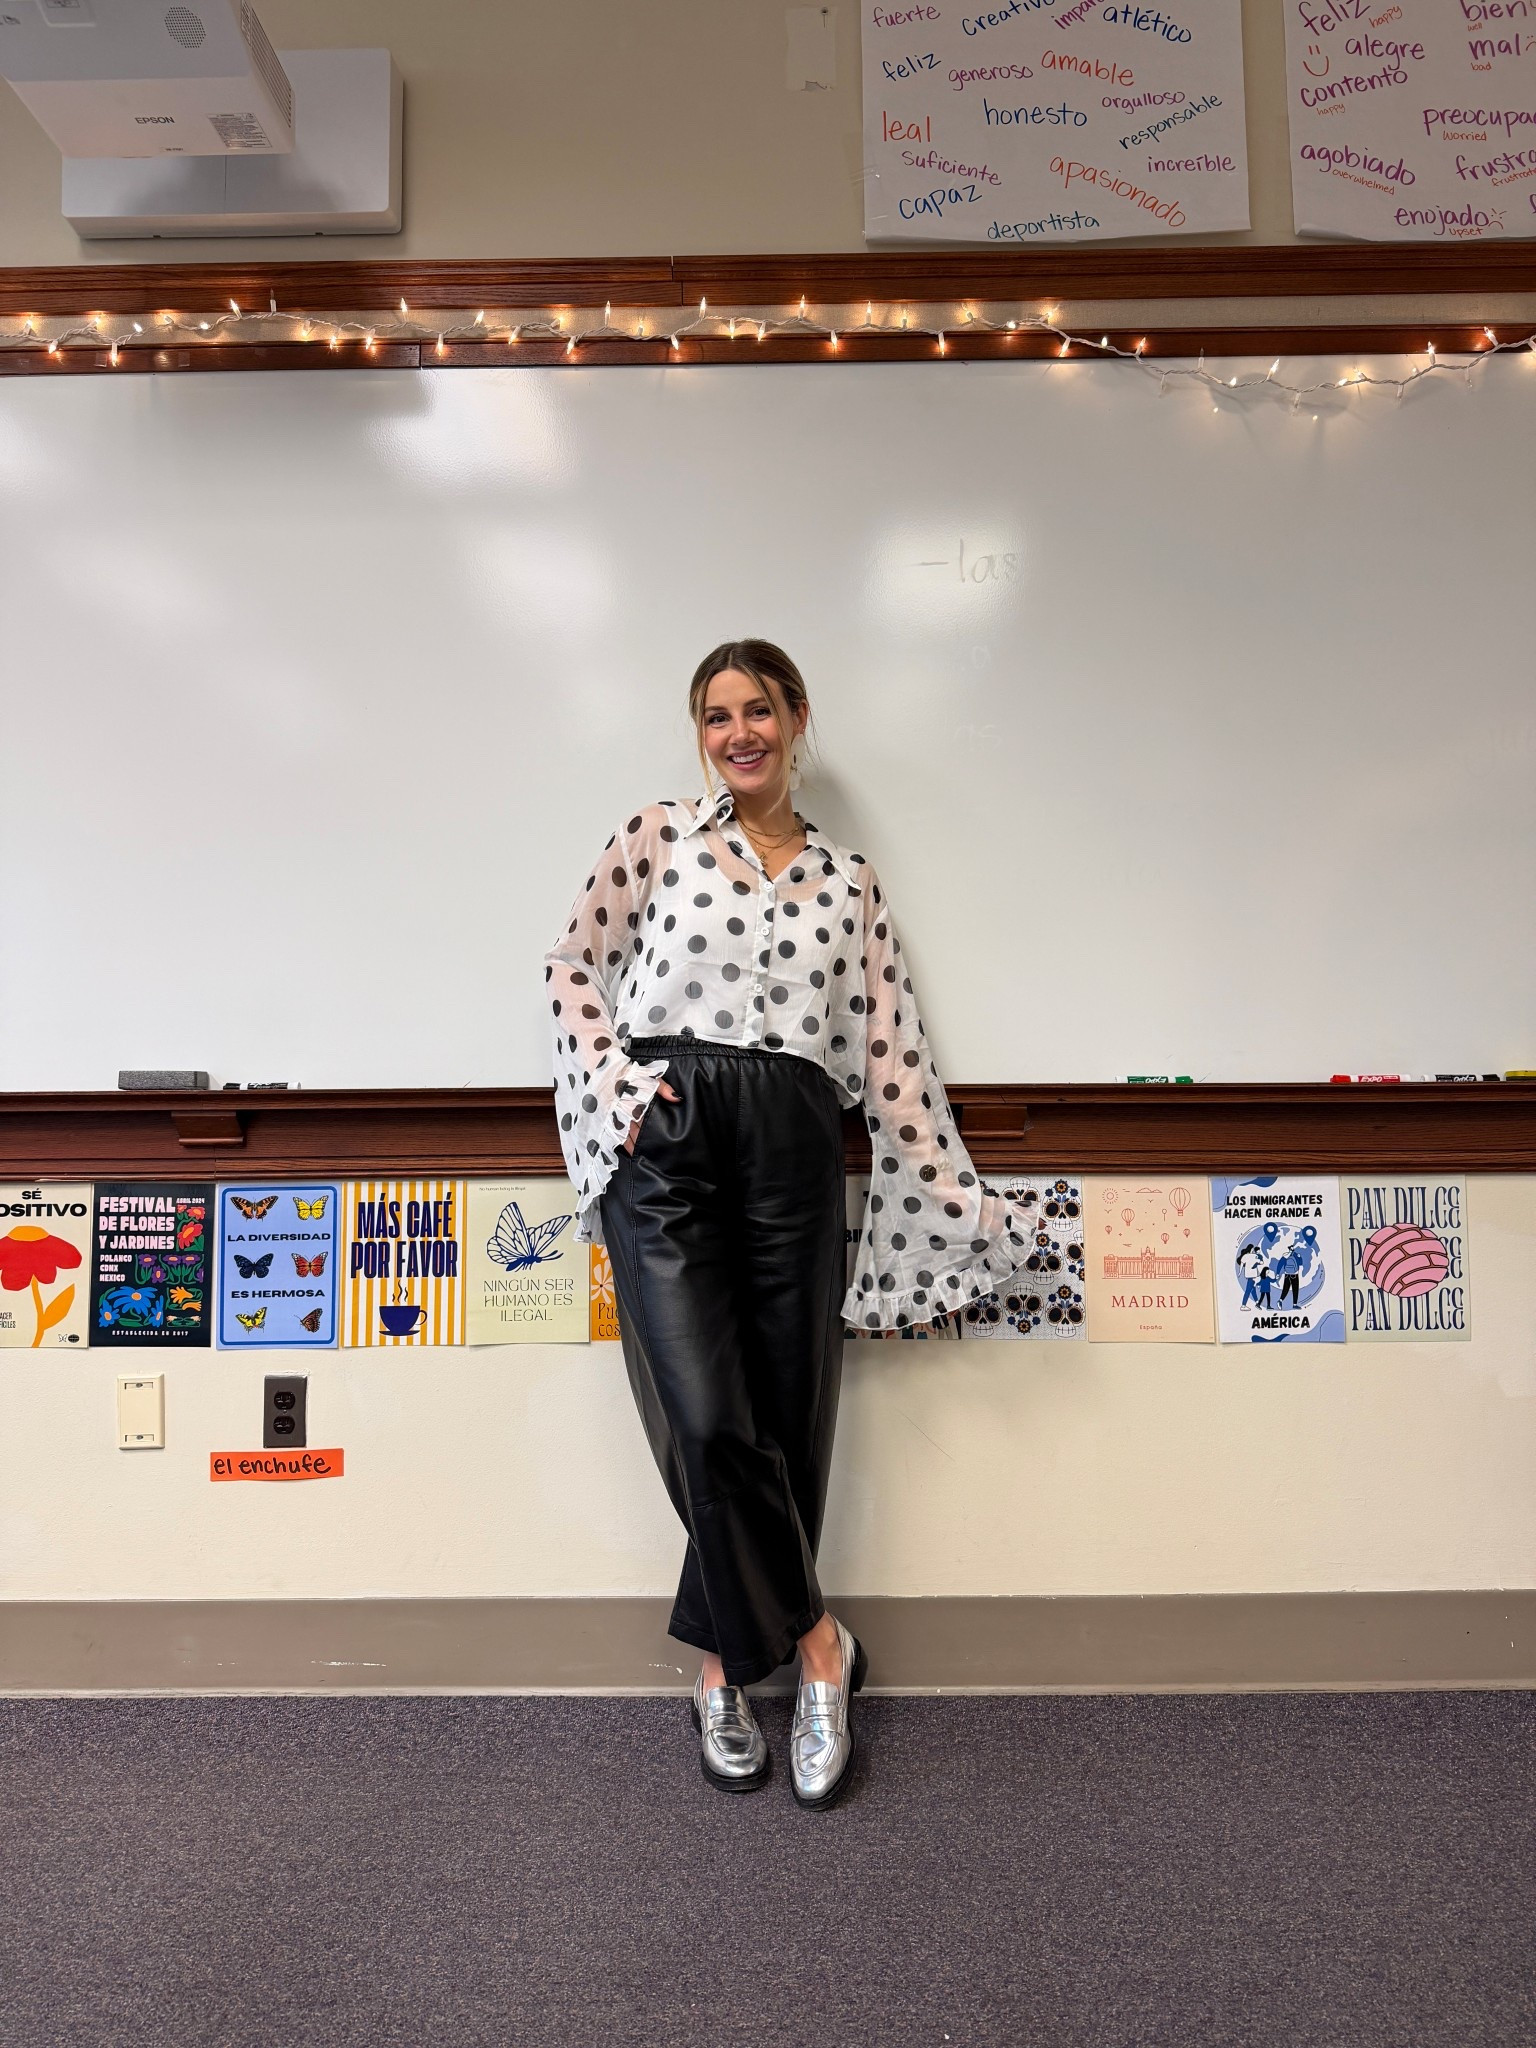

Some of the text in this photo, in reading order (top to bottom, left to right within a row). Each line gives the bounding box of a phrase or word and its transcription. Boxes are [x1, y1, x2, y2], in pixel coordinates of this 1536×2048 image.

[872, 3, 941, 28] fuerte
[1298, 0, 1371, 36] feliz
[1369, 6, 1402, 28] happy
[1460, 0, 1527, 21] bien
[1103, 4, 1192, 43] atlético
[1345, 33, 1426, 70] alegre
[1468, 33, 1521, 60] mal
[882, 52, 942, 83] feliz
[948, 63, 1034, 91] generoso
[1041, 49, 1135, 87] amable
[1470, 61, 1492, 71] bad
[1300, 67, 1408, 108] contento
[983, 97, 1087, 127] honesto
[1101, 90, 1186, 115] orgulloso
[1316, 102, 1346, 116] happy
[135, 116, 176, 125] EPSON
[882, 110, 932, 143] leal
[1118, 93, 1223, 150] responsable
[1423, 108, 1536, 138] preocupa
[902, 150, 1002, 186] suficiente
[1147, 154, 1236, 173] increíble
[1300, 144, 1416, 186] agobiado
[899, 183, 983, 220] capaz
[1049, 155, 1187, 229] apasionado
[987, 210, 1100, 242] deportista
[1394, 203, 1489, 236] enojado
[22, 1188, 42, 1200] SÉ
[100, 1196, 176, 1213] FESTIVAL
[1226, 1195, 1323, 1206] LOS INMIGRANTES
[357, 1191, 453, 1239] MÁS CAFÉ
[1224, 1207, 1322, 1219] HACEN GRANDE A
[1347, 1186, 1462, 1229] PAN DULCE
[99, 1216, 175, 1232] DE FLORES
[99, 1235, 175, 1250] Y JARDINES
[227, 1233, 331, 1242] LA DIVERSIDAD
[100, 1255, 132, 1263] POLANCO
[350, 1240, 458, 1279] POR FAVOR
[231, 1289, 326, 1299] ES HERMOSA
[483, 1277, 574, 1292] NINGÚN SER
[484, 1293, 573, 1307] HUMANO ES
[1112, 1295, 1189, 1308] MADRID
[1350, 1287, 1465, 1331] PAN DULCE
[500, 1309, 553, 1322] ILEGAL
[1251, 1313, 1311, 1329] AMÉRICA
[213, 1454, 332, 1475] el enchufe
